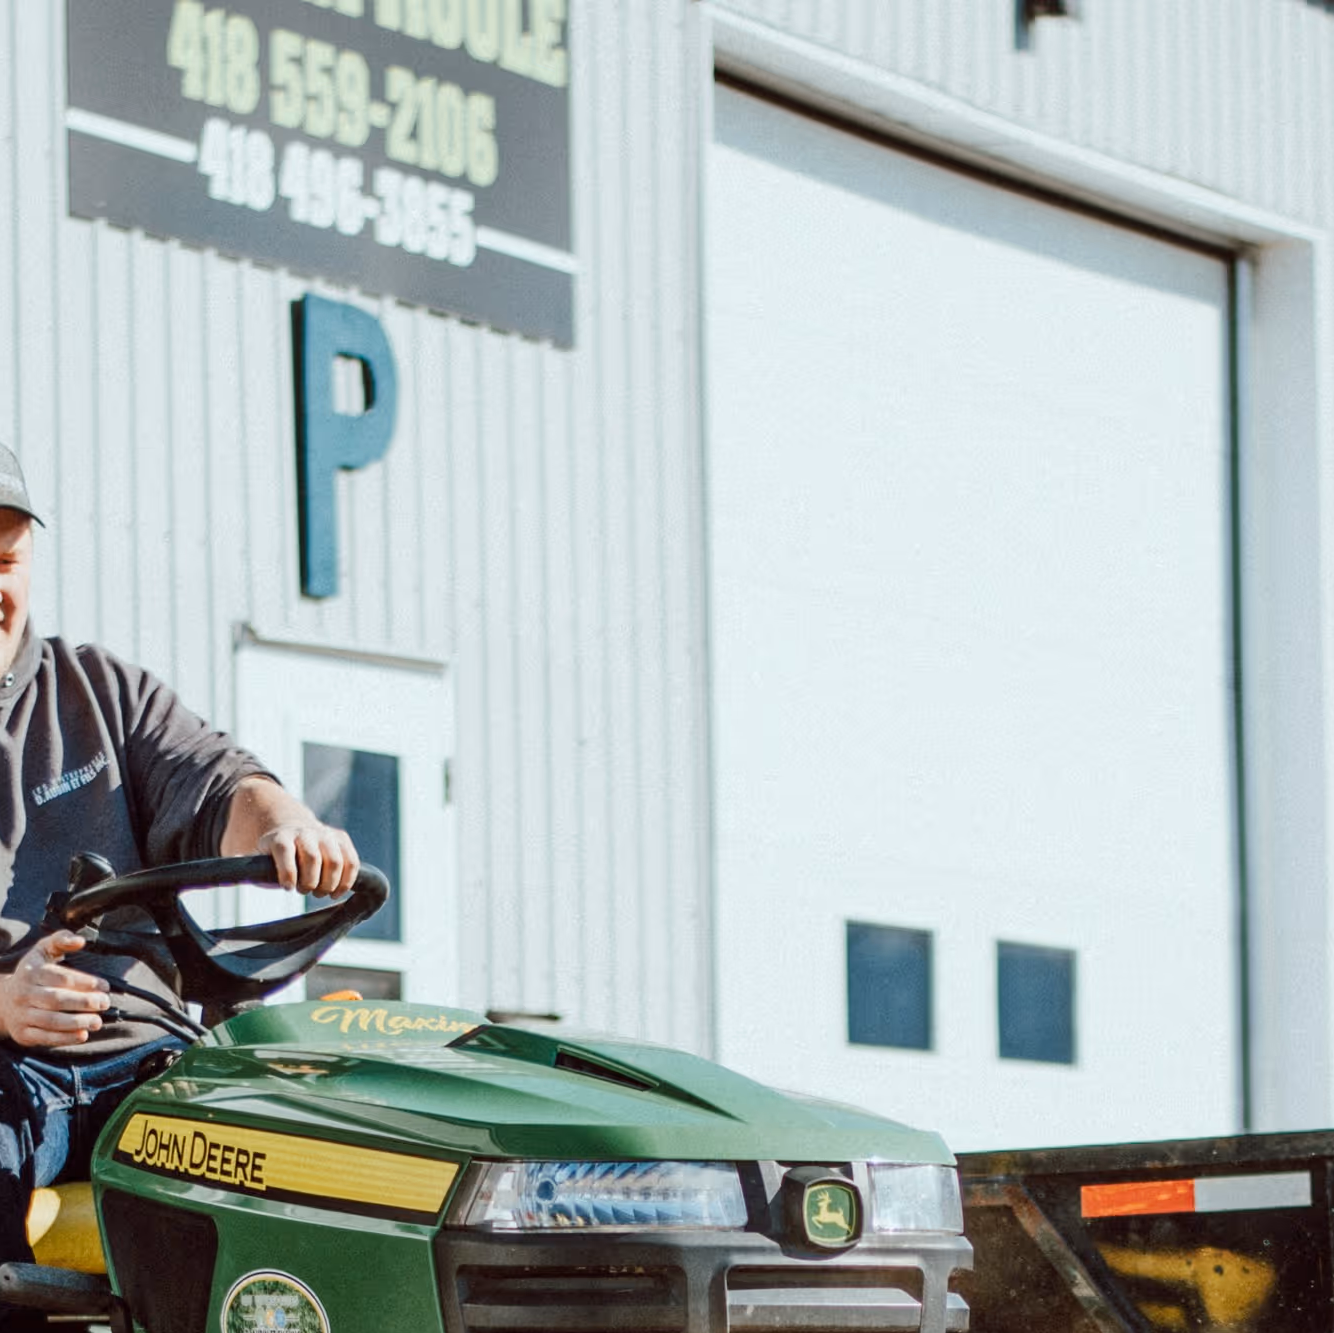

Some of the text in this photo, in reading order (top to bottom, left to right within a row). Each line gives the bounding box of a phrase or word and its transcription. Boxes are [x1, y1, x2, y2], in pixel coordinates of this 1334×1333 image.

[169, 1, 497, 187] 418 559-2106
[198, 117, 276, 211] 418
[293, 293, 399, 597] P
[134, 1119, 267, 1185] JOHN DEERE
